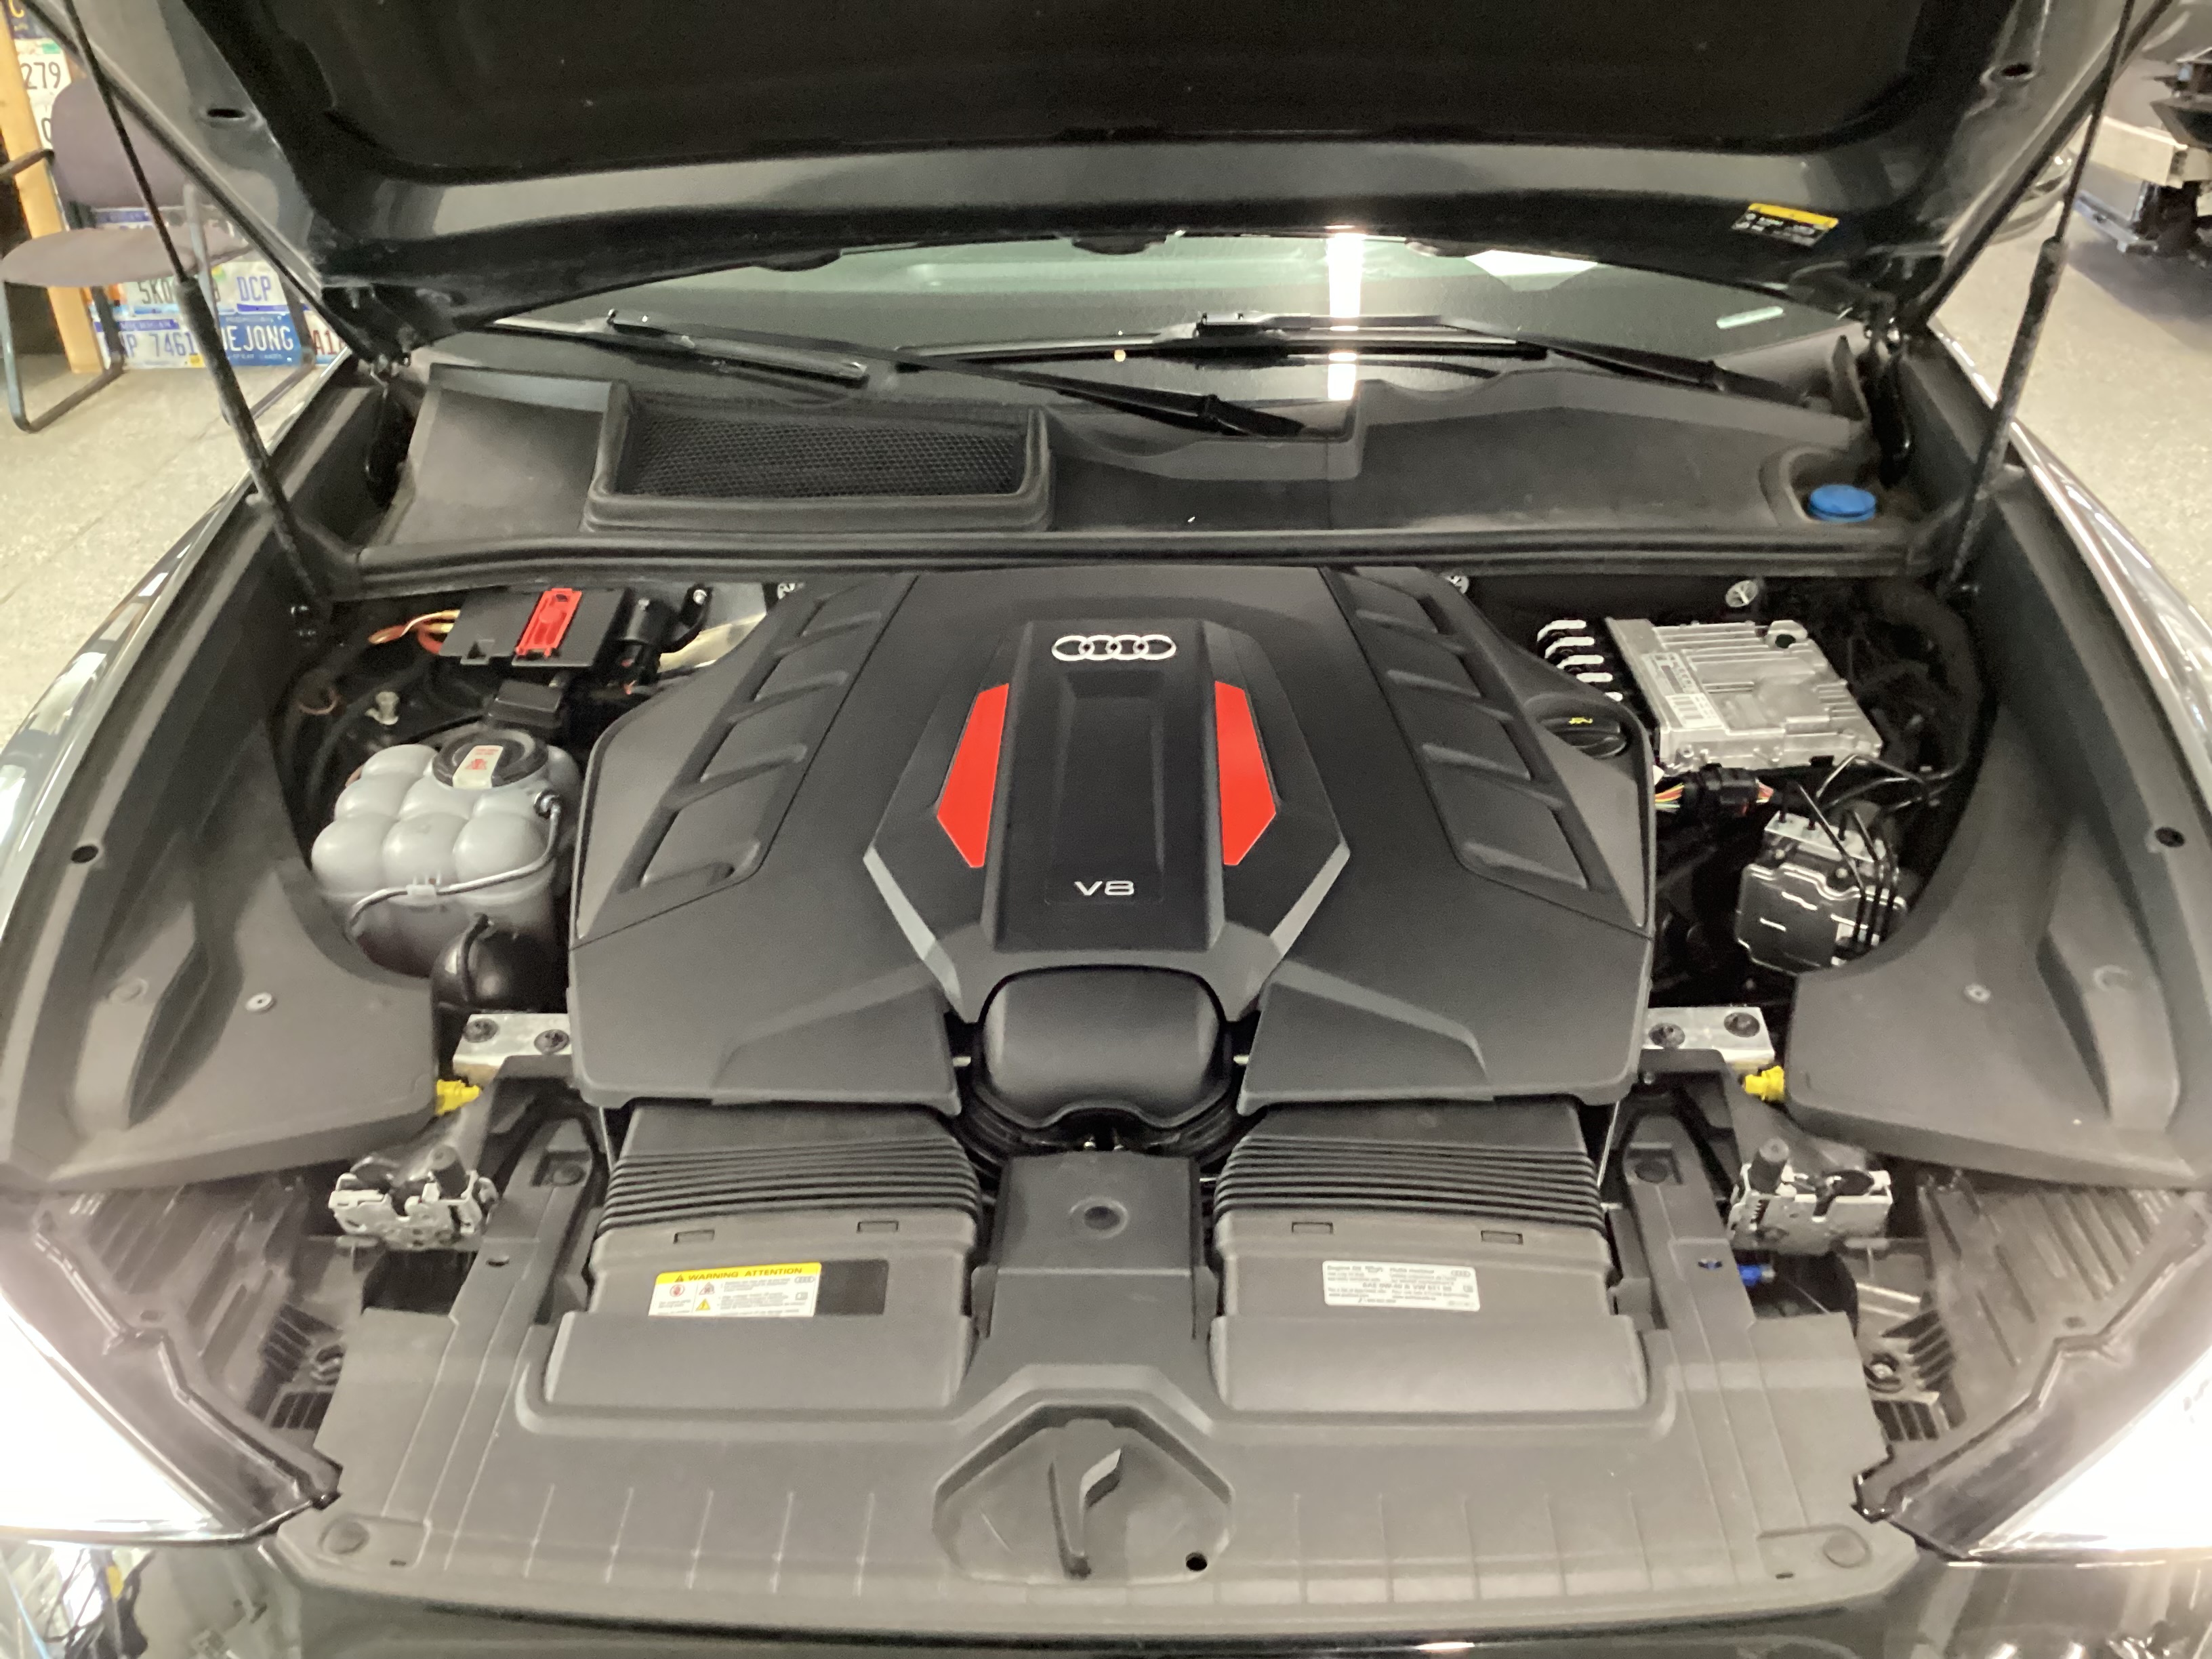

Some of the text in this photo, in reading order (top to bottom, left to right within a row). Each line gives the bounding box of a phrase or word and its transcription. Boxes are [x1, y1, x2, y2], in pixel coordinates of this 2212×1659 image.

[237, 276, 271, 301] DCP
[1074, 880, 1134, 896] V8
[688, 1267, 802, 1281] WARNING ATTENTION
